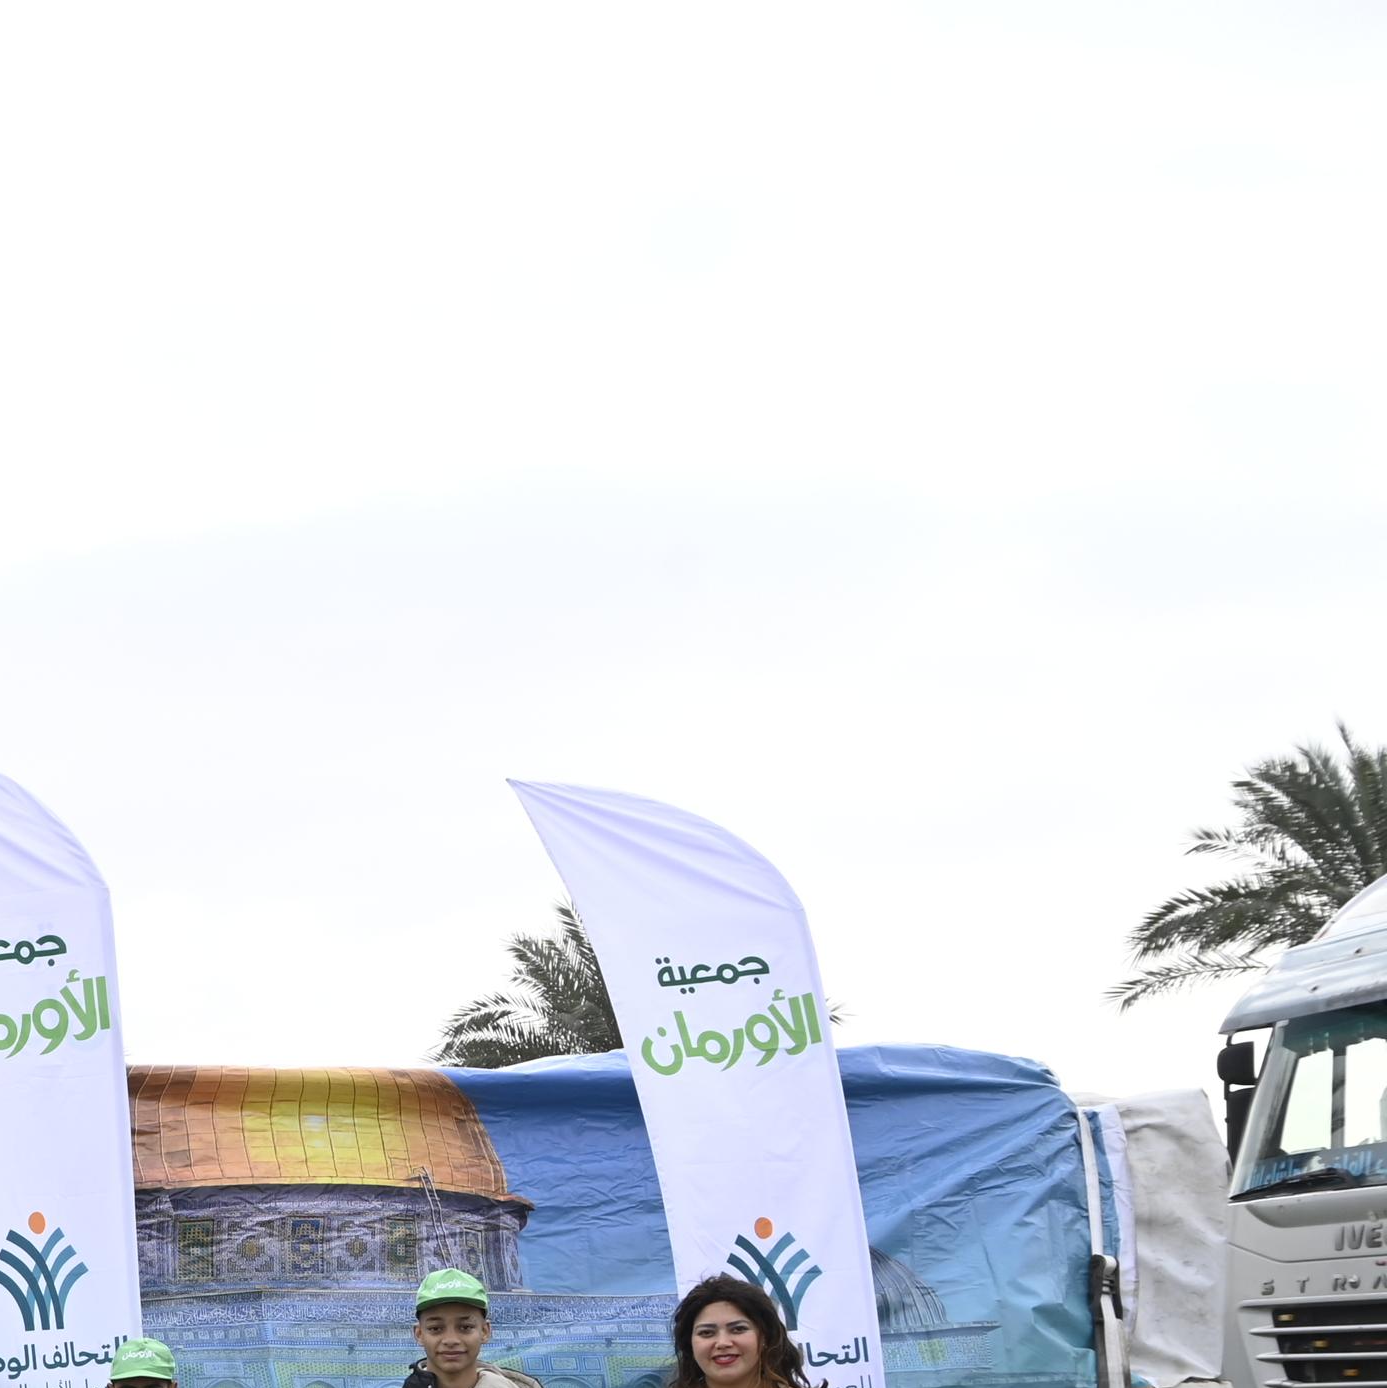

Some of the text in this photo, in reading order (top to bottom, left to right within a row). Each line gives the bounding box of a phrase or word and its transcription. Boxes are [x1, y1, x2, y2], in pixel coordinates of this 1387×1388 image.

[655, 954, 770, 995] جمعية
[641, 990, 822, 1076] الأورمان
[1334, 1222, 1387, 1251] IVE
[42, 1335, 127, 1369] لتحالف
[798, 1337, 869, 1367] التحا
